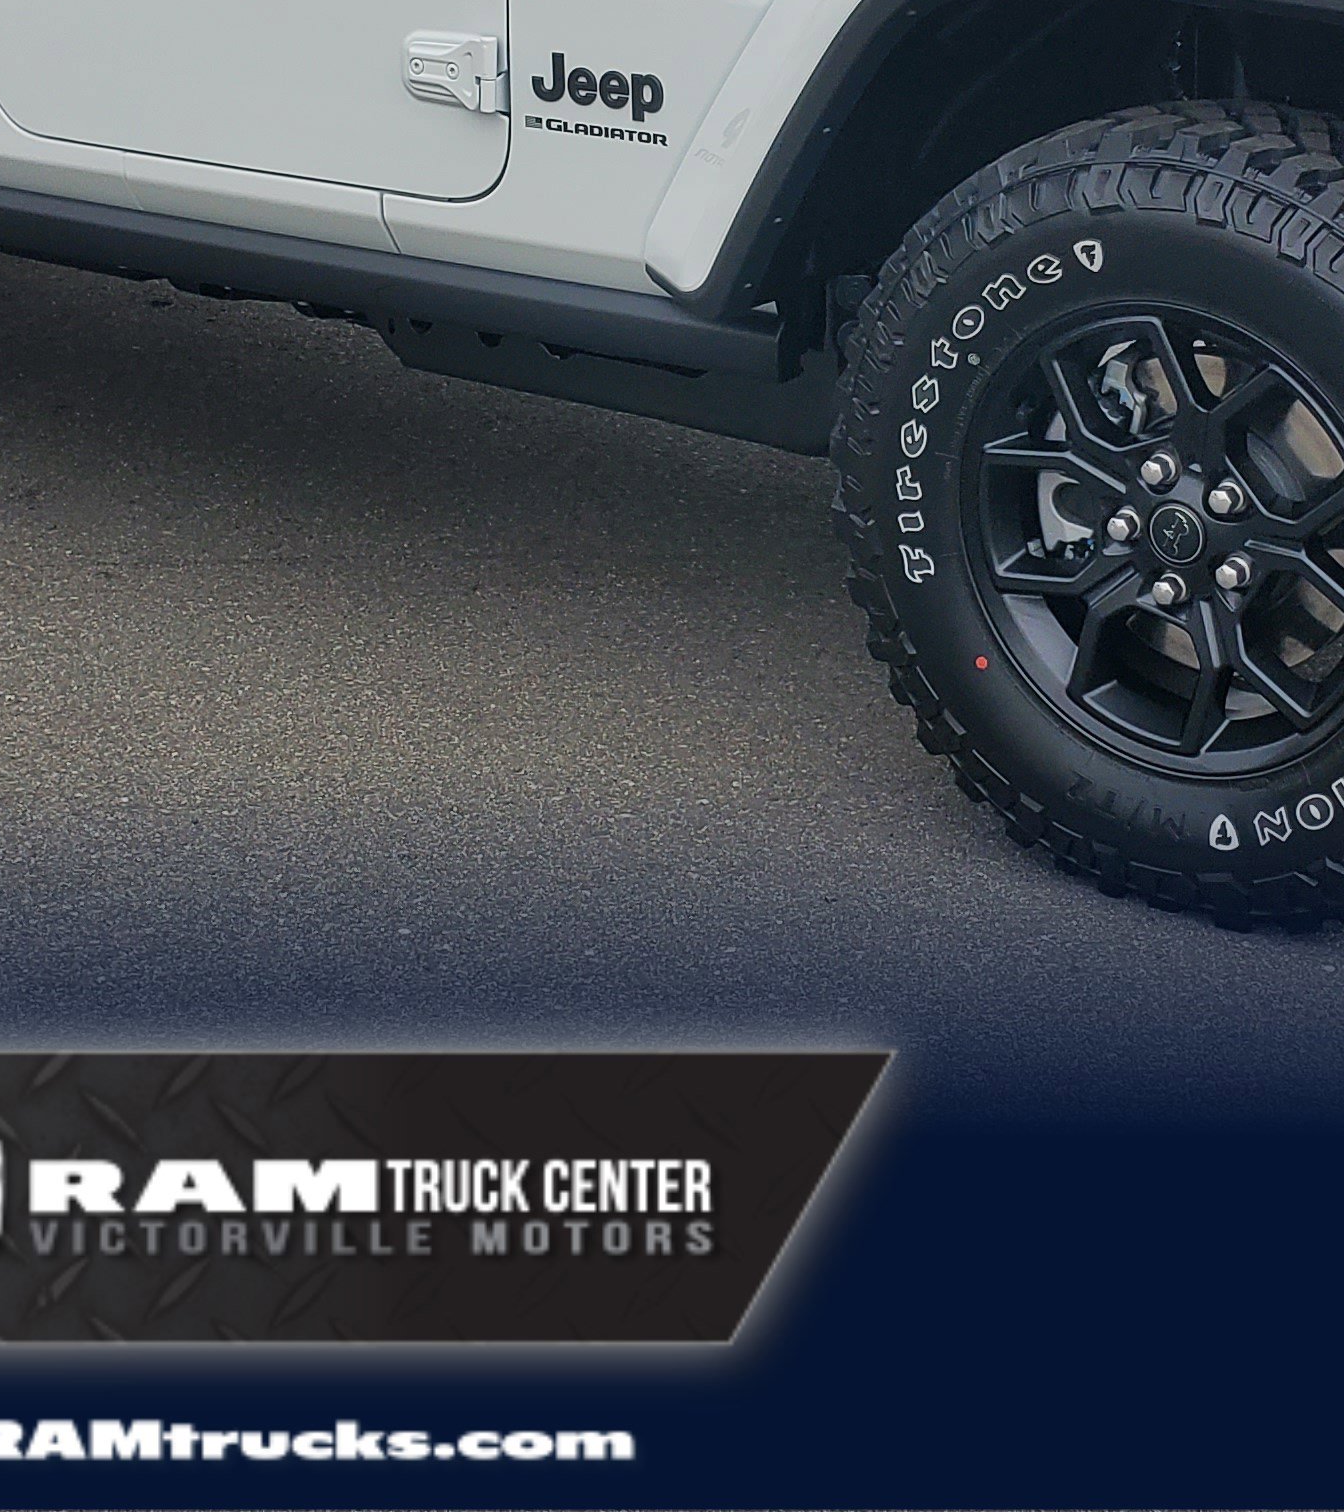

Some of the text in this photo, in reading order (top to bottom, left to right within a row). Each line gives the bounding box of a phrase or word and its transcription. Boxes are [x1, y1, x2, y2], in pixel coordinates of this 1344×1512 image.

[530, 51, 665, 123] Jeep
[545, 117, 669, 148] GLADIATOR
[895, 253, 1064, 585] Firestone
